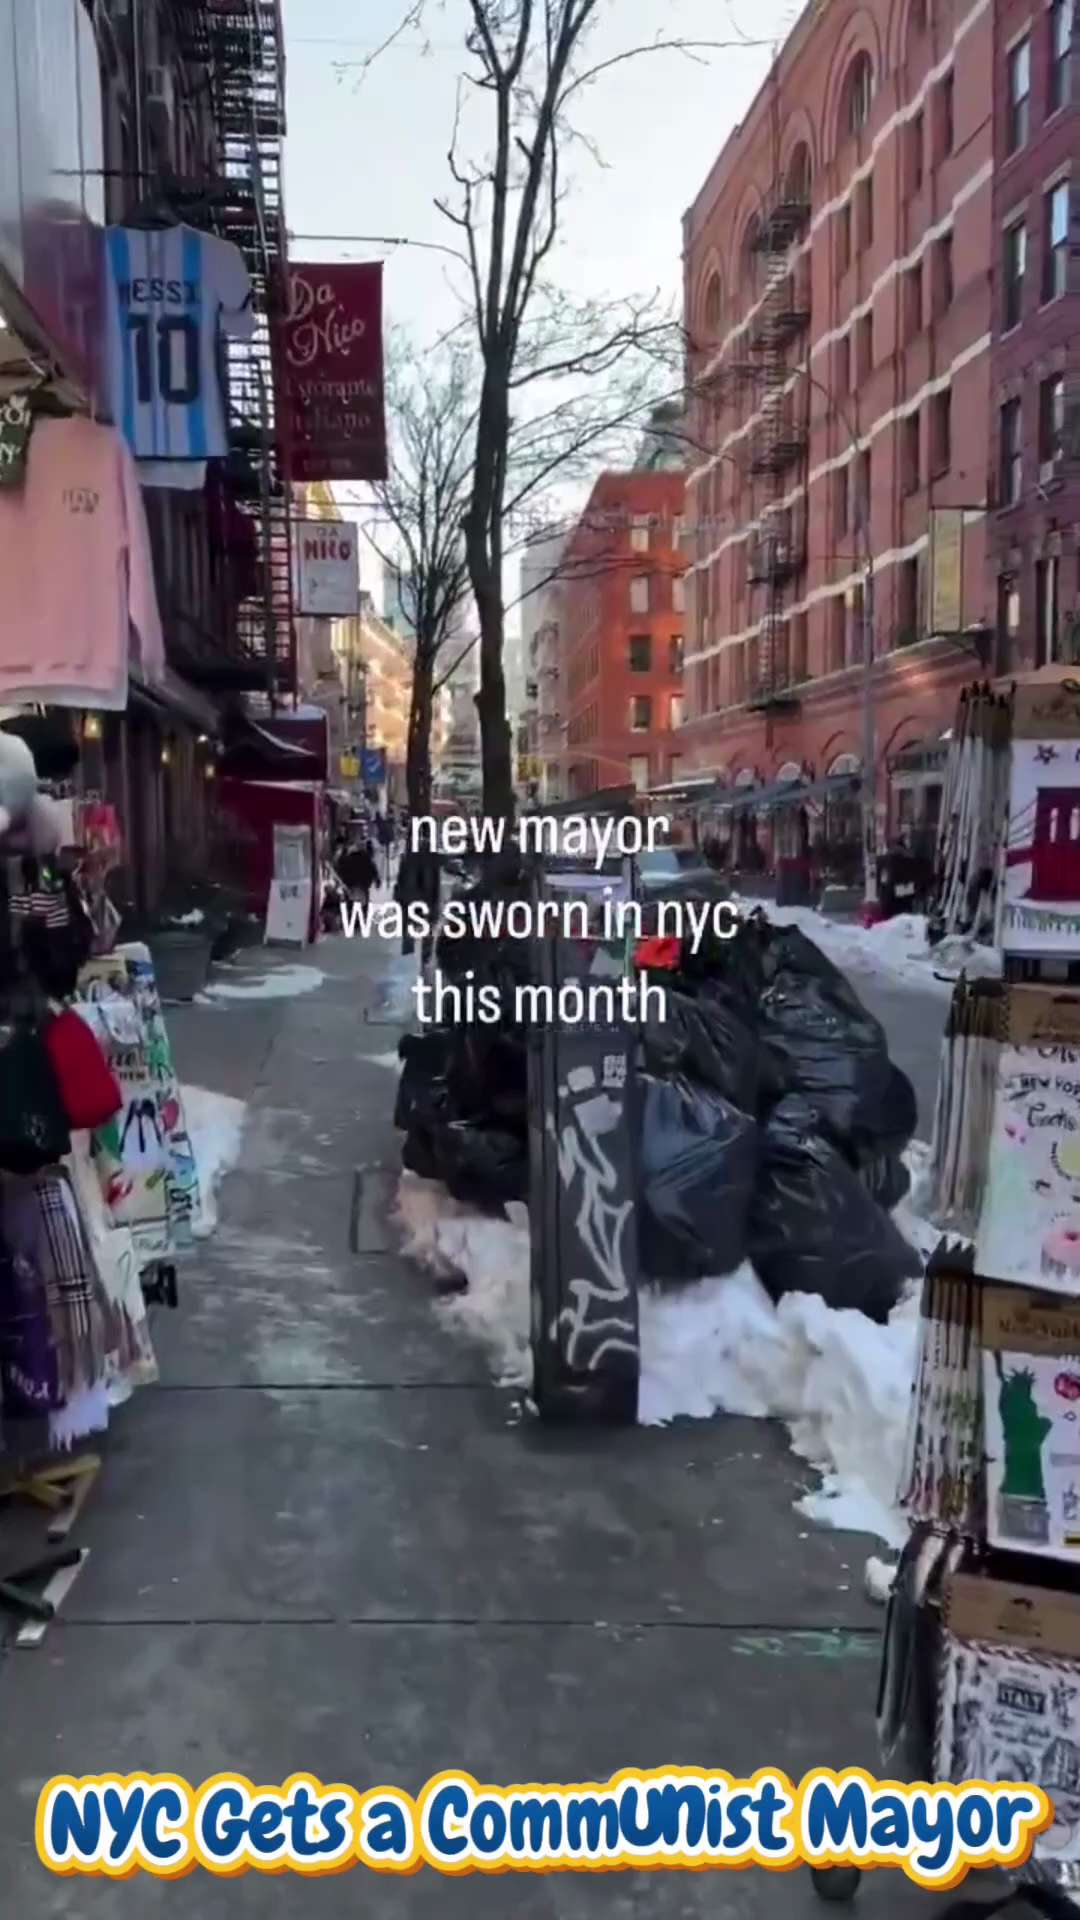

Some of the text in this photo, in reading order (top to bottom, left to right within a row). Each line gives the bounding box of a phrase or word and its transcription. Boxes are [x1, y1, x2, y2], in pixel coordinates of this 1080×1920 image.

[284, 272, 336, 322] Da
[124, 313, 201, 405] 10
[286, 304, 366, 366] Nico
[303, 539, 352, 561] NICO
